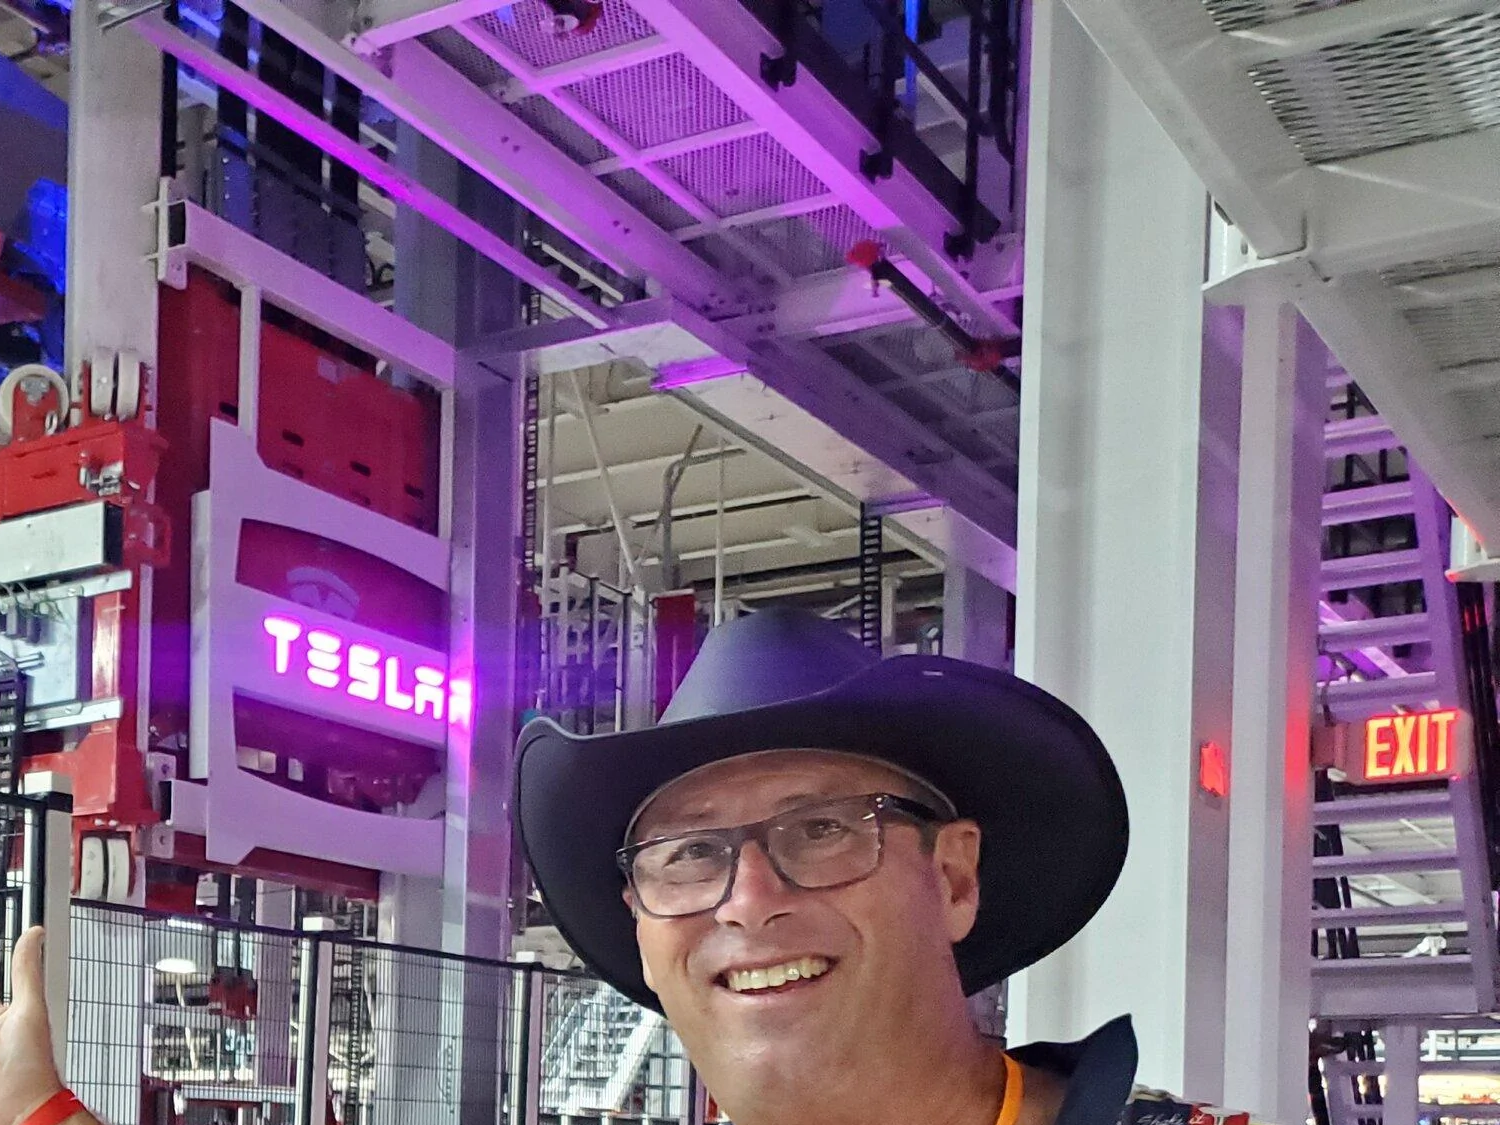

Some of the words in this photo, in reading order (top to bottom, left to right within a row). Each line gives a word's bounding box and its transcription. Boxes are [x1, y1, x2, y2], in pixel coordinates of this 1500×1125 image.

[263, 616, 445, 720] TESLA
[1365, 711, 1457, 779] EXIT
[1189, 1110, 1207, 1125] it
